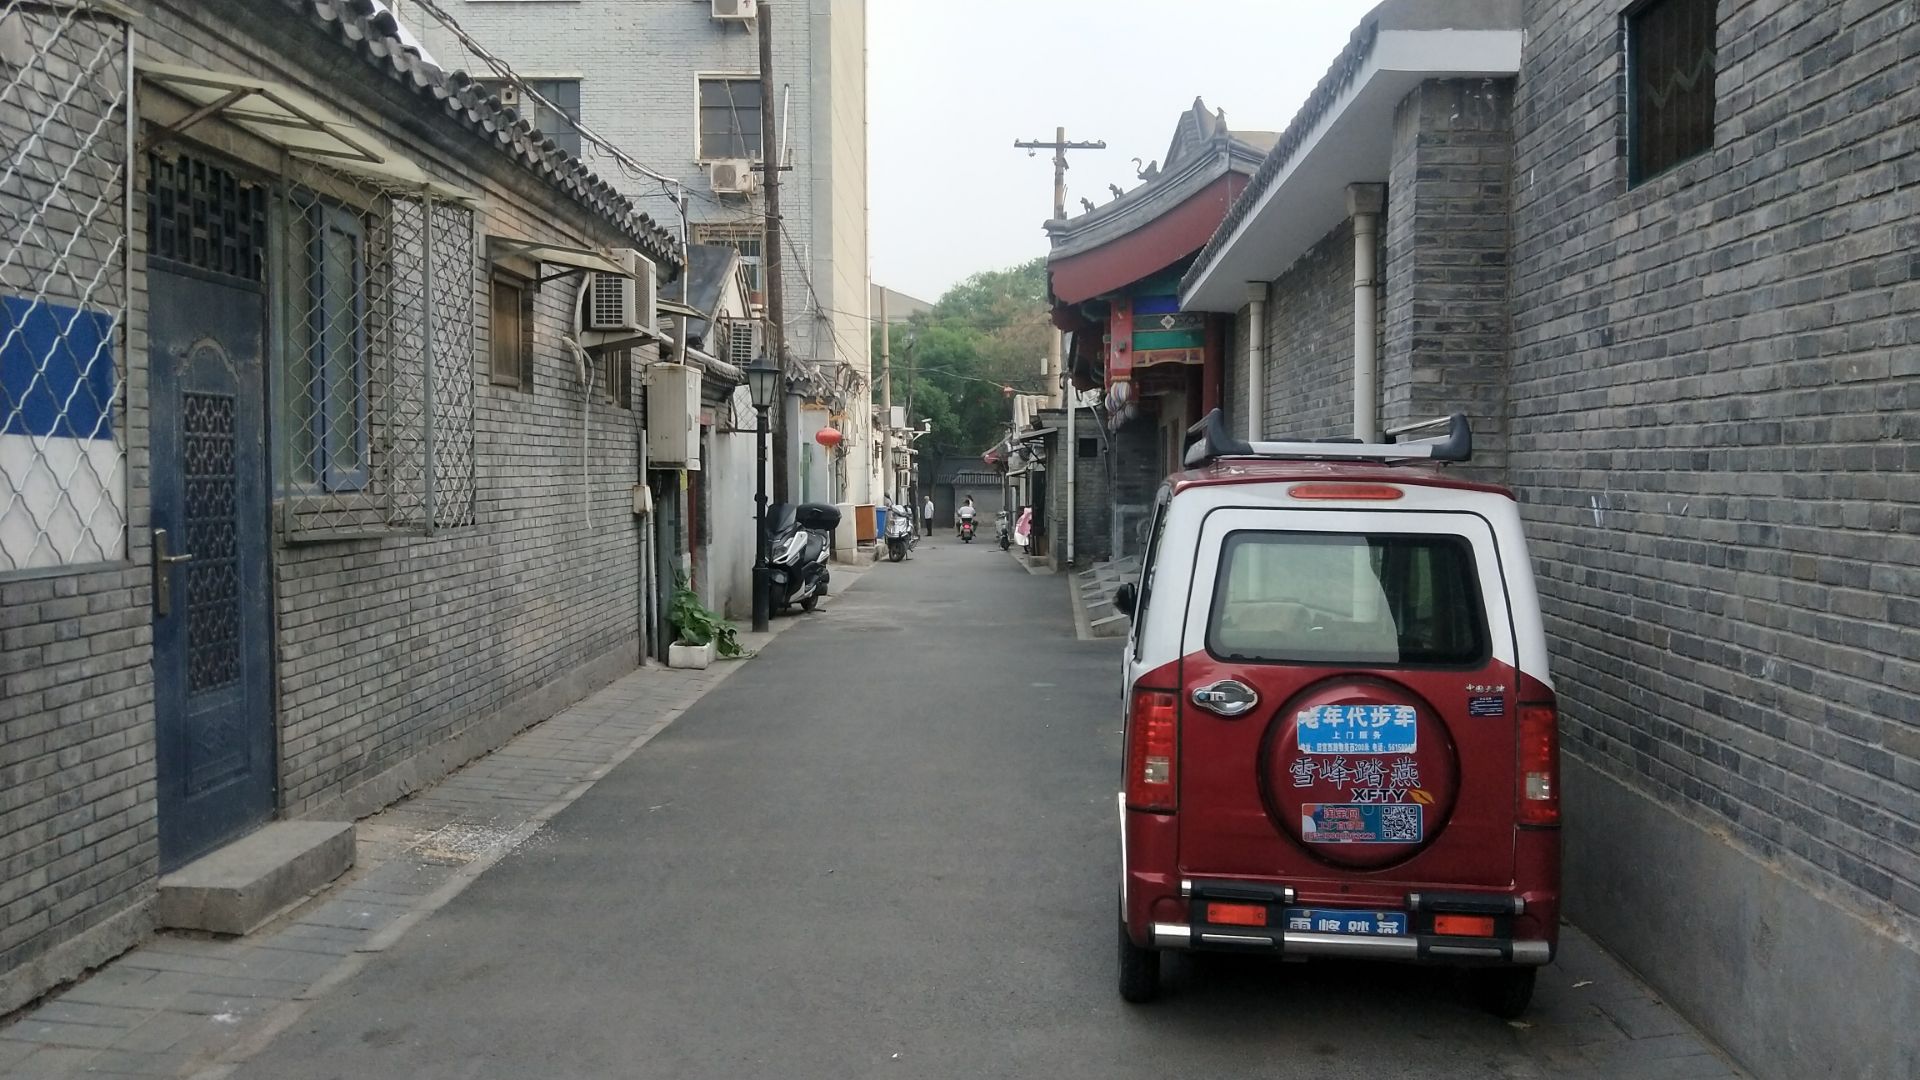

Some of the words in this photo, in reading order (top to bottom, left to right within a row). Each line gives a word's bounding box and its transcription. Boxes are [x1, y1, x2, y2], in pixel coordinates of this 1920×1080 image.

[1332, 731, 1381, 740] 上门服务
[1290, 755, 1421, 790] 雪峰踏燕
[1351, 788, 1407, 803] XFTY
[1324, 807, 1360, 819] 淘宝网
